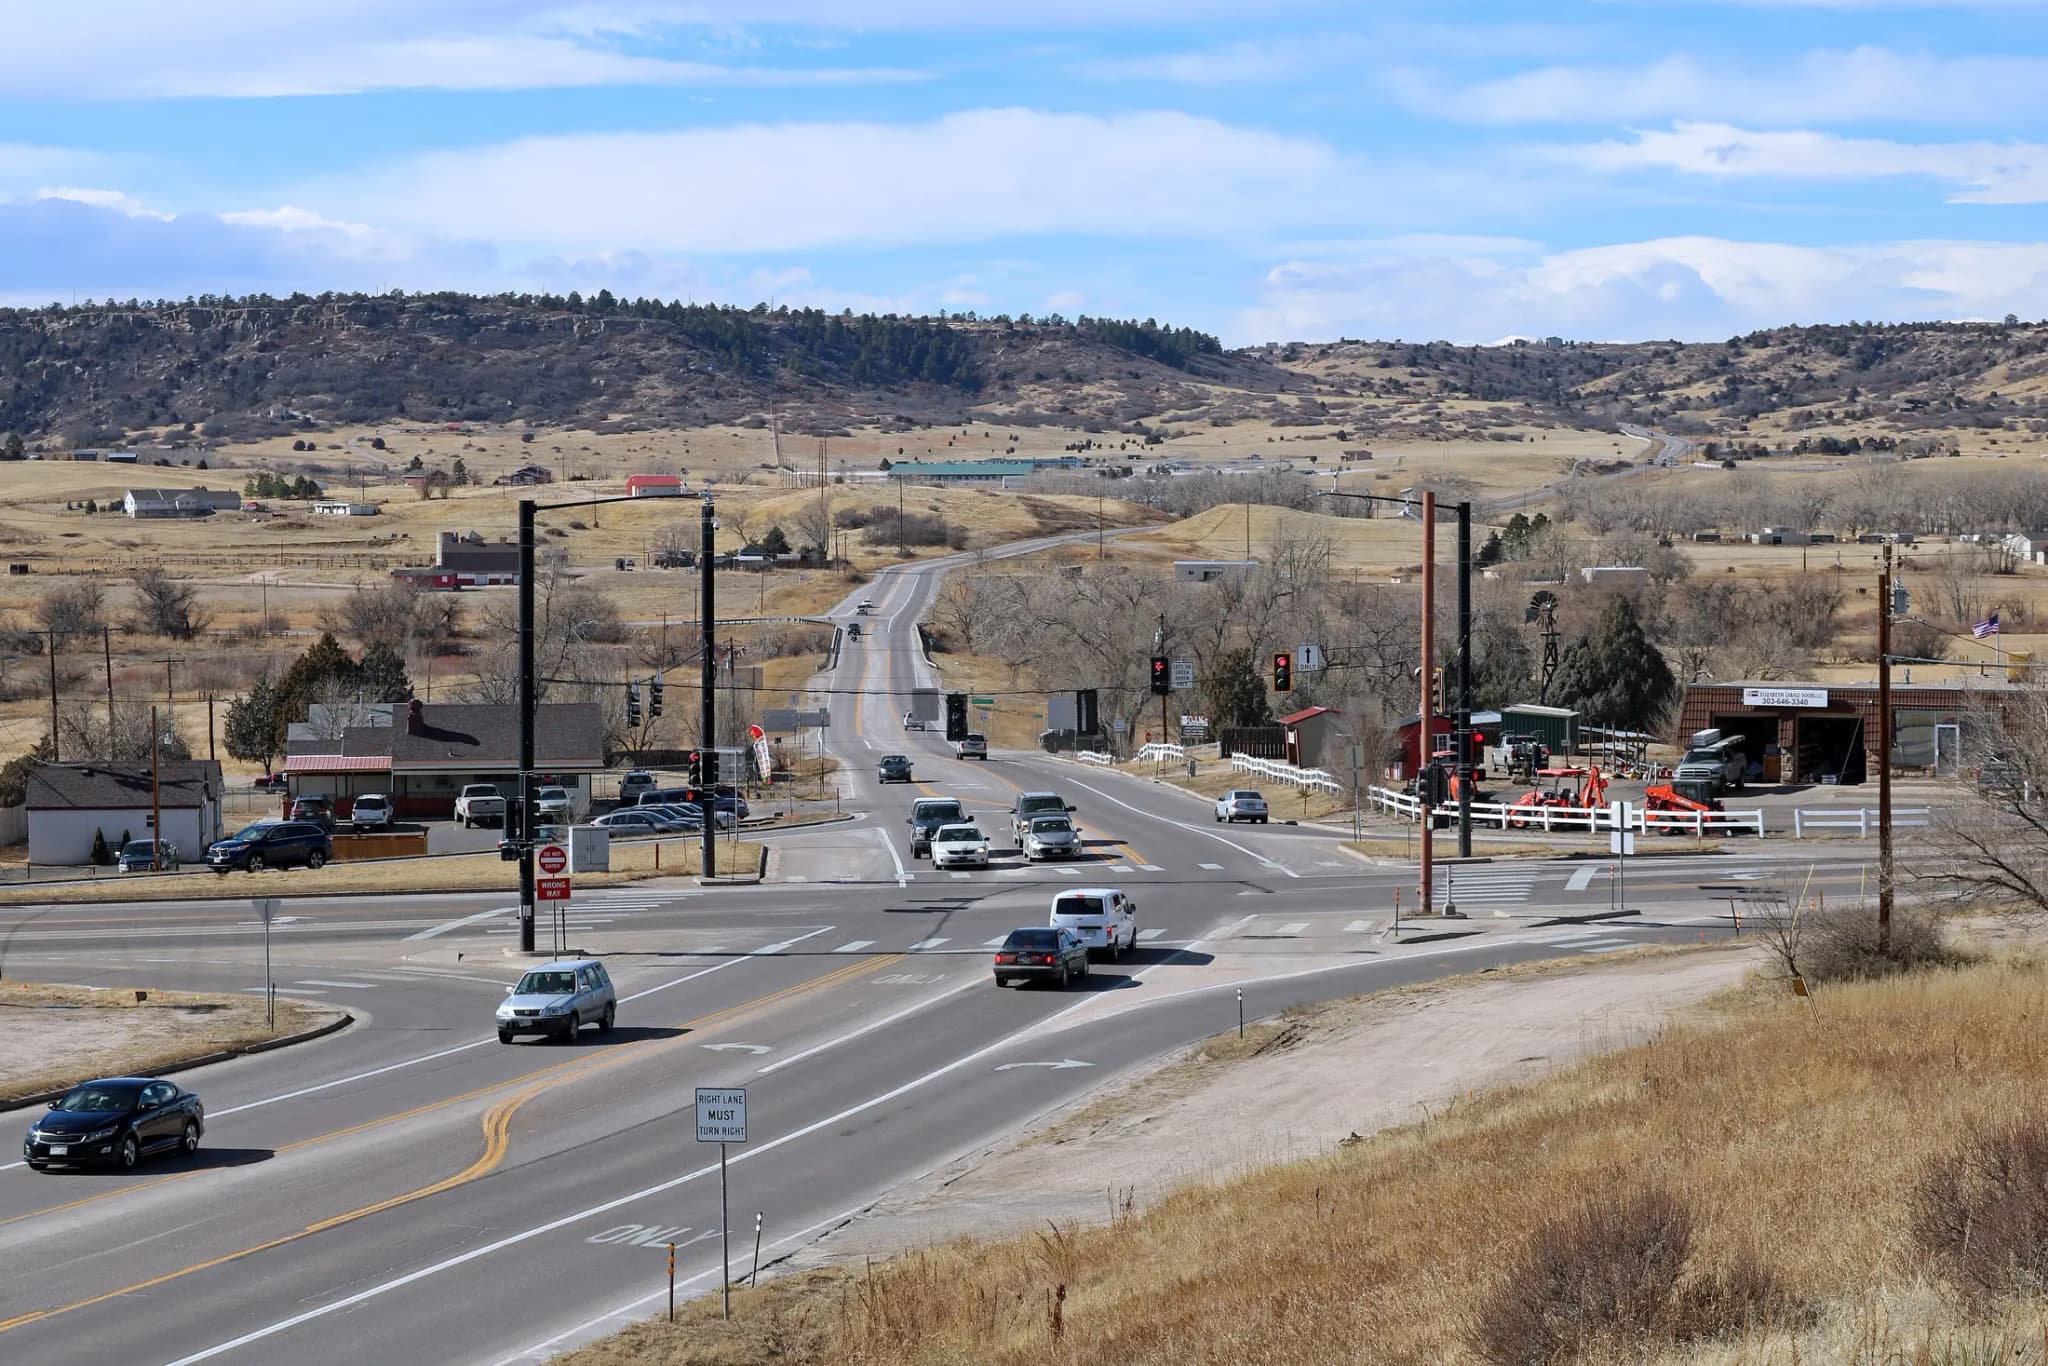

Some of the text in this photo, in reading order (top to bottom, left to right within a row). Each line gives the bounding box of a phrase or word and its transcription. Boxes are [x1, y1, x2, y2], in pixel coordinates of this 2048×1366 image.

[541, 881, 566, 889] WRONG
[871, 974, 952, 984] ONLY
[698, 1095, 743, 1104] RIGHT LANE
[708, 1110, 735, 1121] MUST
[699, 1127, 744, 1136] TURN RIGHT
[584, 1223, 735, 1249] ONLY
